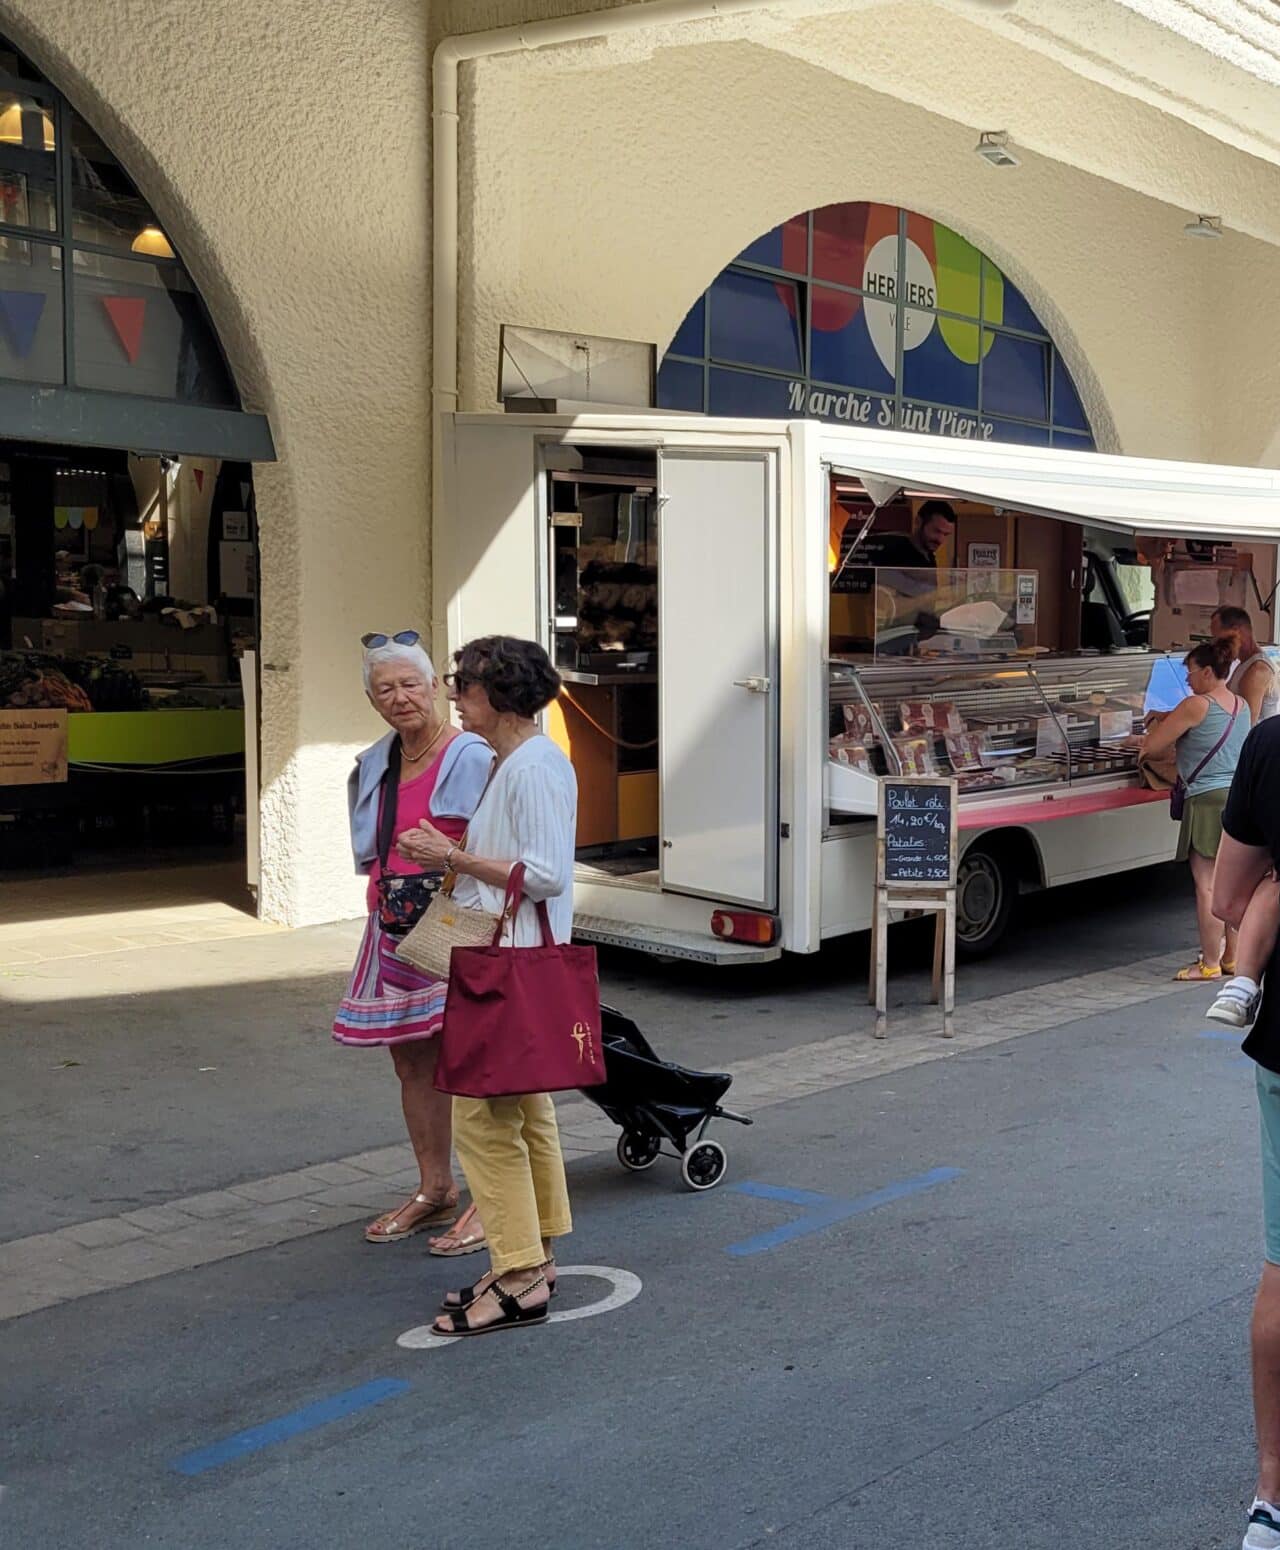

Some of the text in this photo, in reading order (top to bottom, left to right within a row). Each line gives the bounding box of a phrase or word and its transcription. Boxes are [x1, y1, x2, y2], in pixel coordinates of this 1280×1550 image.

[867, 271, 935, 308] HERIERS
[788, 381, 871, 423] Marché
[887, 789, 919, 808] Poulet
